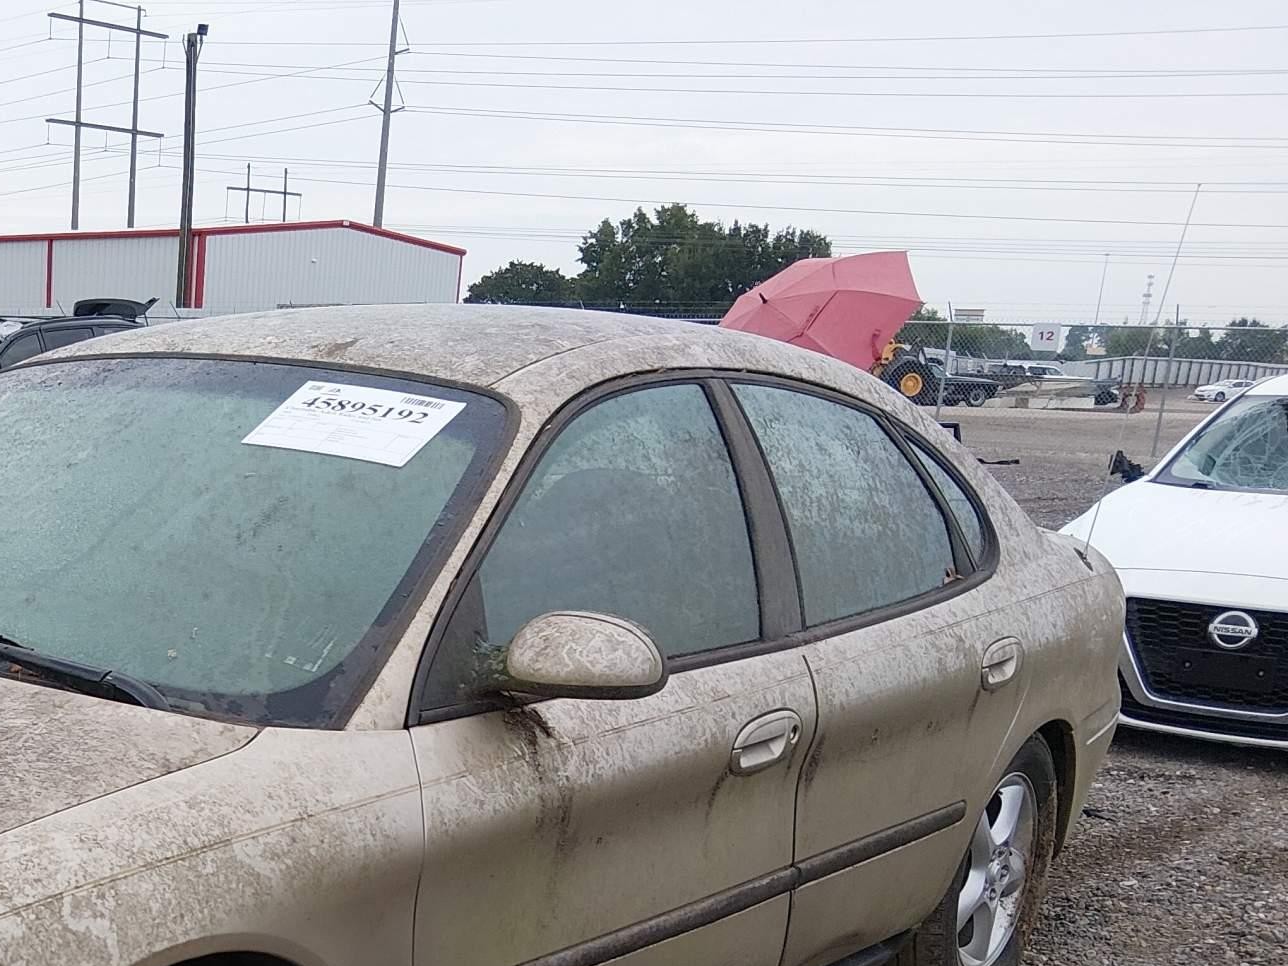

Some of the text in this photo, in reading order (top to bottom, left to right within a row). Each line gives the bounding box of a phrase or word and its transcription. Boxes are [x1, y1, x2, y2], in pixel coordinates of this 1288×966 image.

[1038, 331, 1055, 341] 12
[301, 396, 429, 424] 45895192
[1213, 626, 1252, 635] NISSAN
